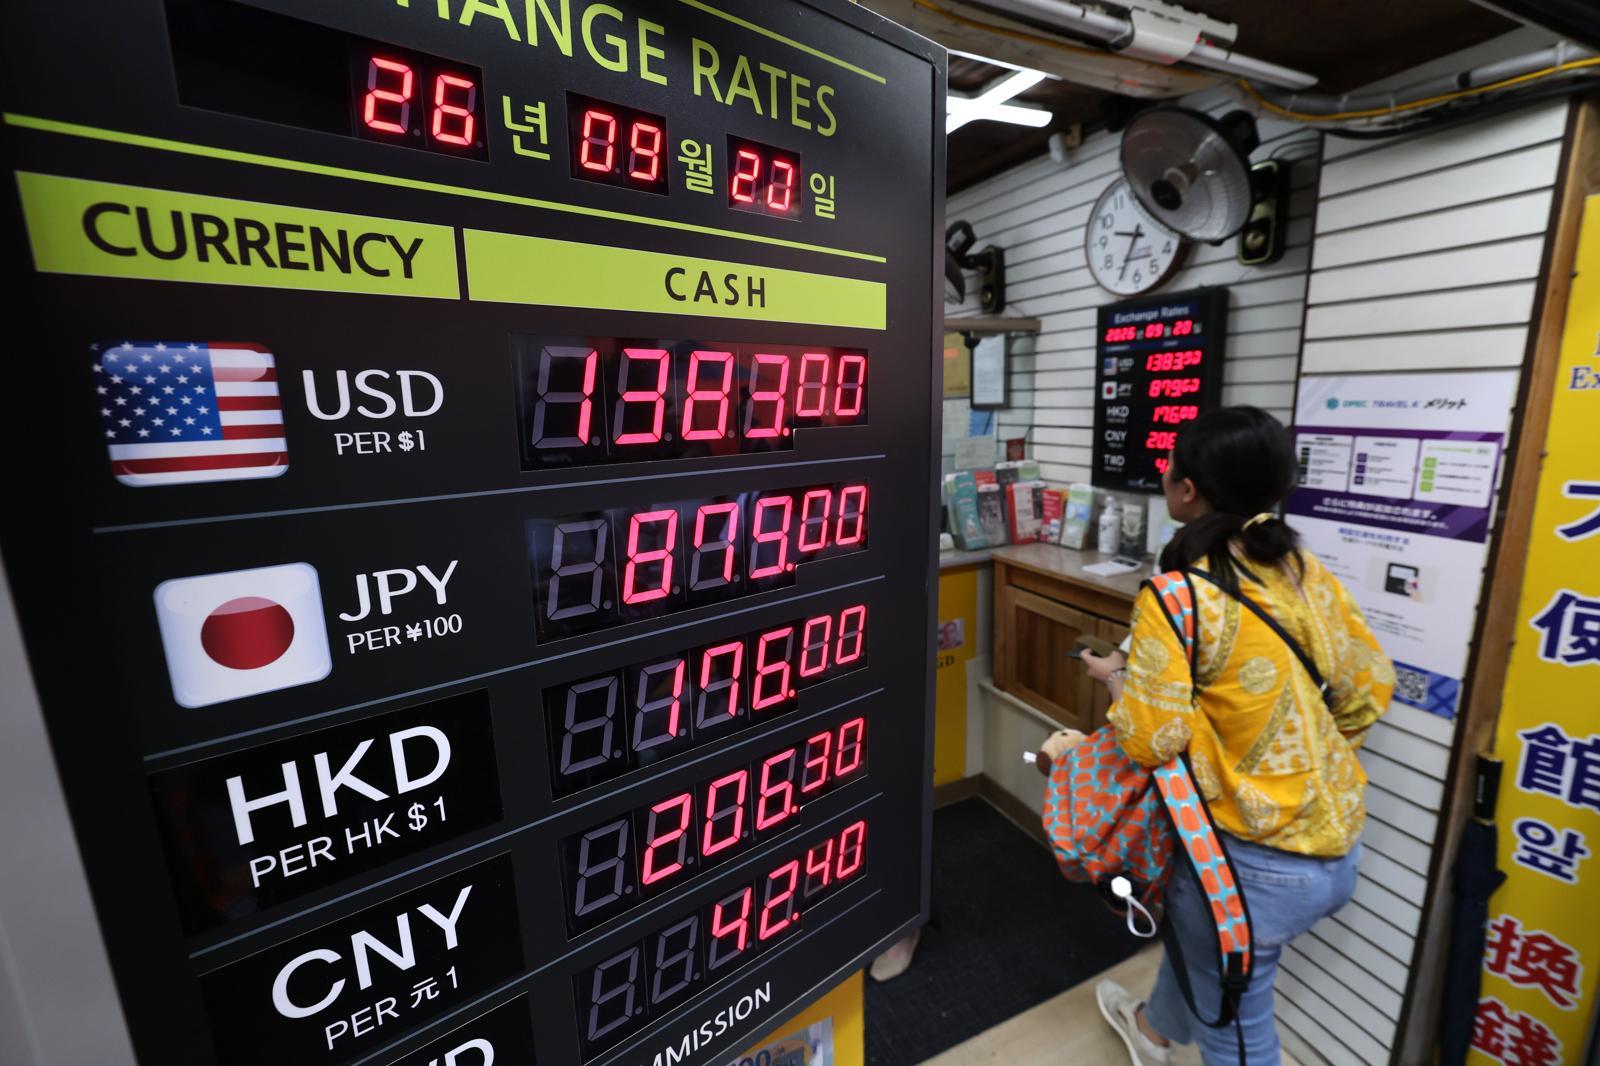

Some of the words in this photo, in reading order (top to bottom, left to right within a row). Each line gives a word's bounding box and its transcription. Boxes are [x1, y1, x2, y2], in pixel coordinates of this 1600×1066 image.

[396, 0, 667, 85] ANGE
[691, 37, 837, 137] RATES
[364, 57, 475, 146] 26
[503, 96, 550, 160] 년
[580, 110, 662, 181] 09
[678, 139, 714, 194] 월
[810, 173, 836, 220] 일
[1113, 194, 1124, 211] 11
[1101, 213, 1114, 229] 10
[82, 202, 424, 279] CURRENCY
[1099, 235, 1108, 249] 9
[1162, 240, 1172, 257] 4
[1104, 254, 1114, 270] 8
[1132, 269, 1142, 284] 6
[1149, 259, 1159, 275] 5
[664, 267, 766, 308] CASH
[1114, 308, 1159, 325] Exchange
[1161, 304, 1190, 319] Rates
[302, 369, 445, 421] USD
[1106, 405, 1130, 418] HKD
[334, 431, 391, 456] PER
[397, 429, 427, 453] $1
[1104, 430, 1127, 442] CNY
[338, 560, 459, 623] JPY
[347, 627, 401, 655] PER
[405, 613, 463, 643] ¥100
[226, 725, 451, 846] HKD
[249, 836, 336, 888] PER
[344, 812, 401, 855] HK
[272, 884, 473, 1019] CNY
[324, 996, 400, 1050] PER
